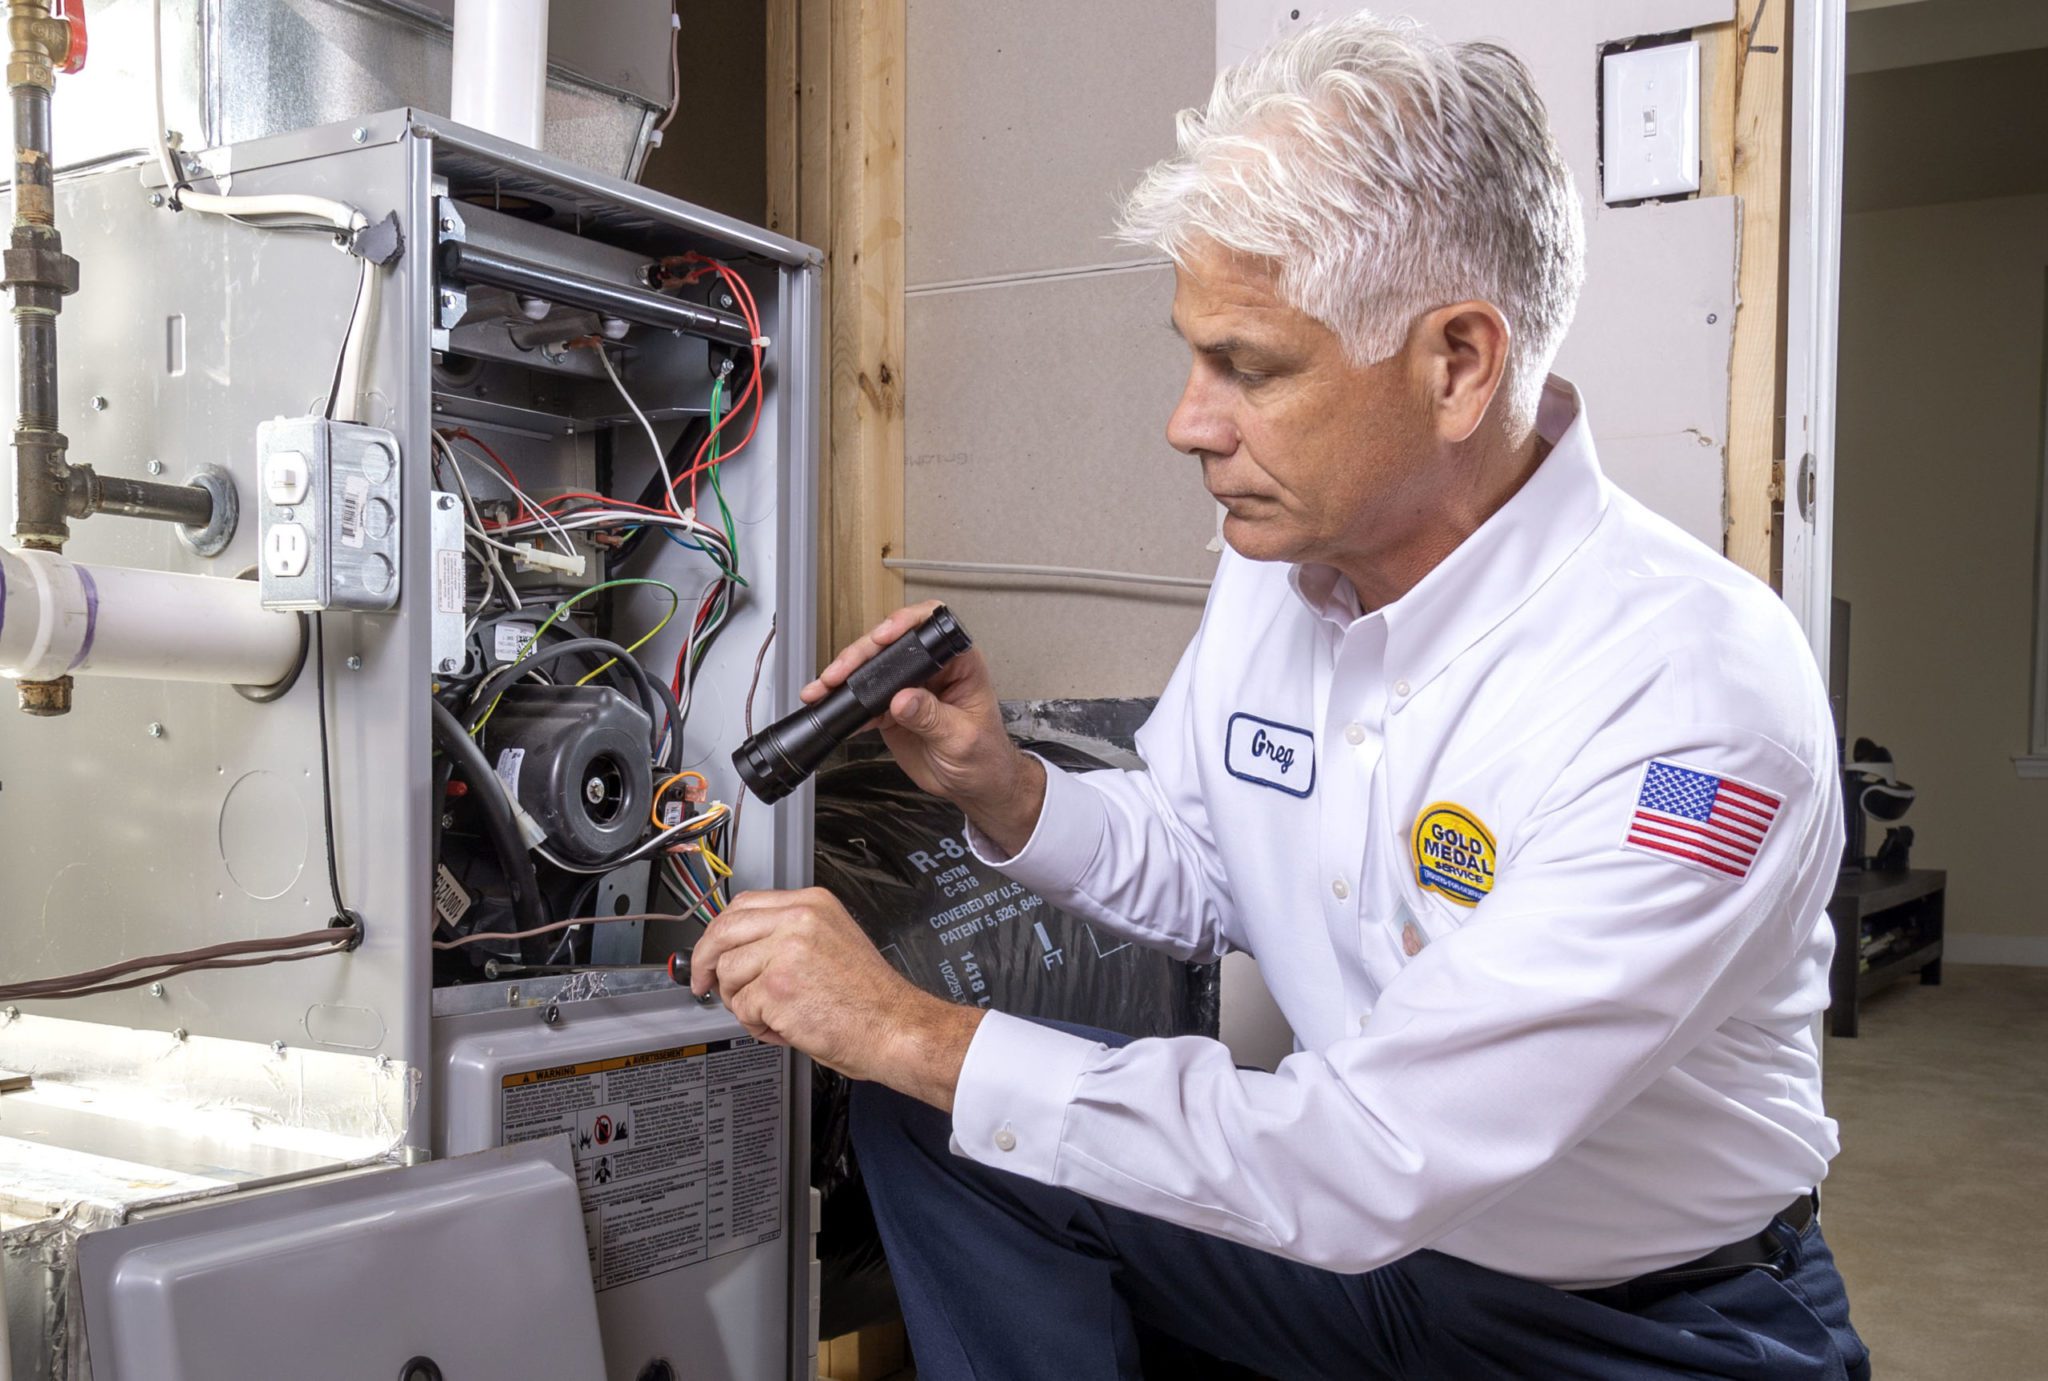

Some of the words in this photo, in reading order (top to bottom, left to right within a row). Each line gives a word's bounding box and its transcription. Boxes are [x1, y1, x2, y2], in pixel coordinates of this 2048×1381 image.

[1251, 728, 1294, 774] Greg
[1432, 823, 1482, 855] GOLD
[1424, 837, 1494, 877] MEDAL
[935, 864, 970, 886] ASTM
[1434, 861, 1484, 884] SERVICE
[943, 876, 980, 898] C-518
[929, 897, 985, 929] COVERED
[983, 890, 1000, 907] BY
[1000, 882, 1026, 900] U.S.
[939, 918, 984, 946] PATENT
[960, 951, 986, 993] 1418
[1043, 948, 1064, 972] FT
[536, 1066, 576, 1080] WARNING
